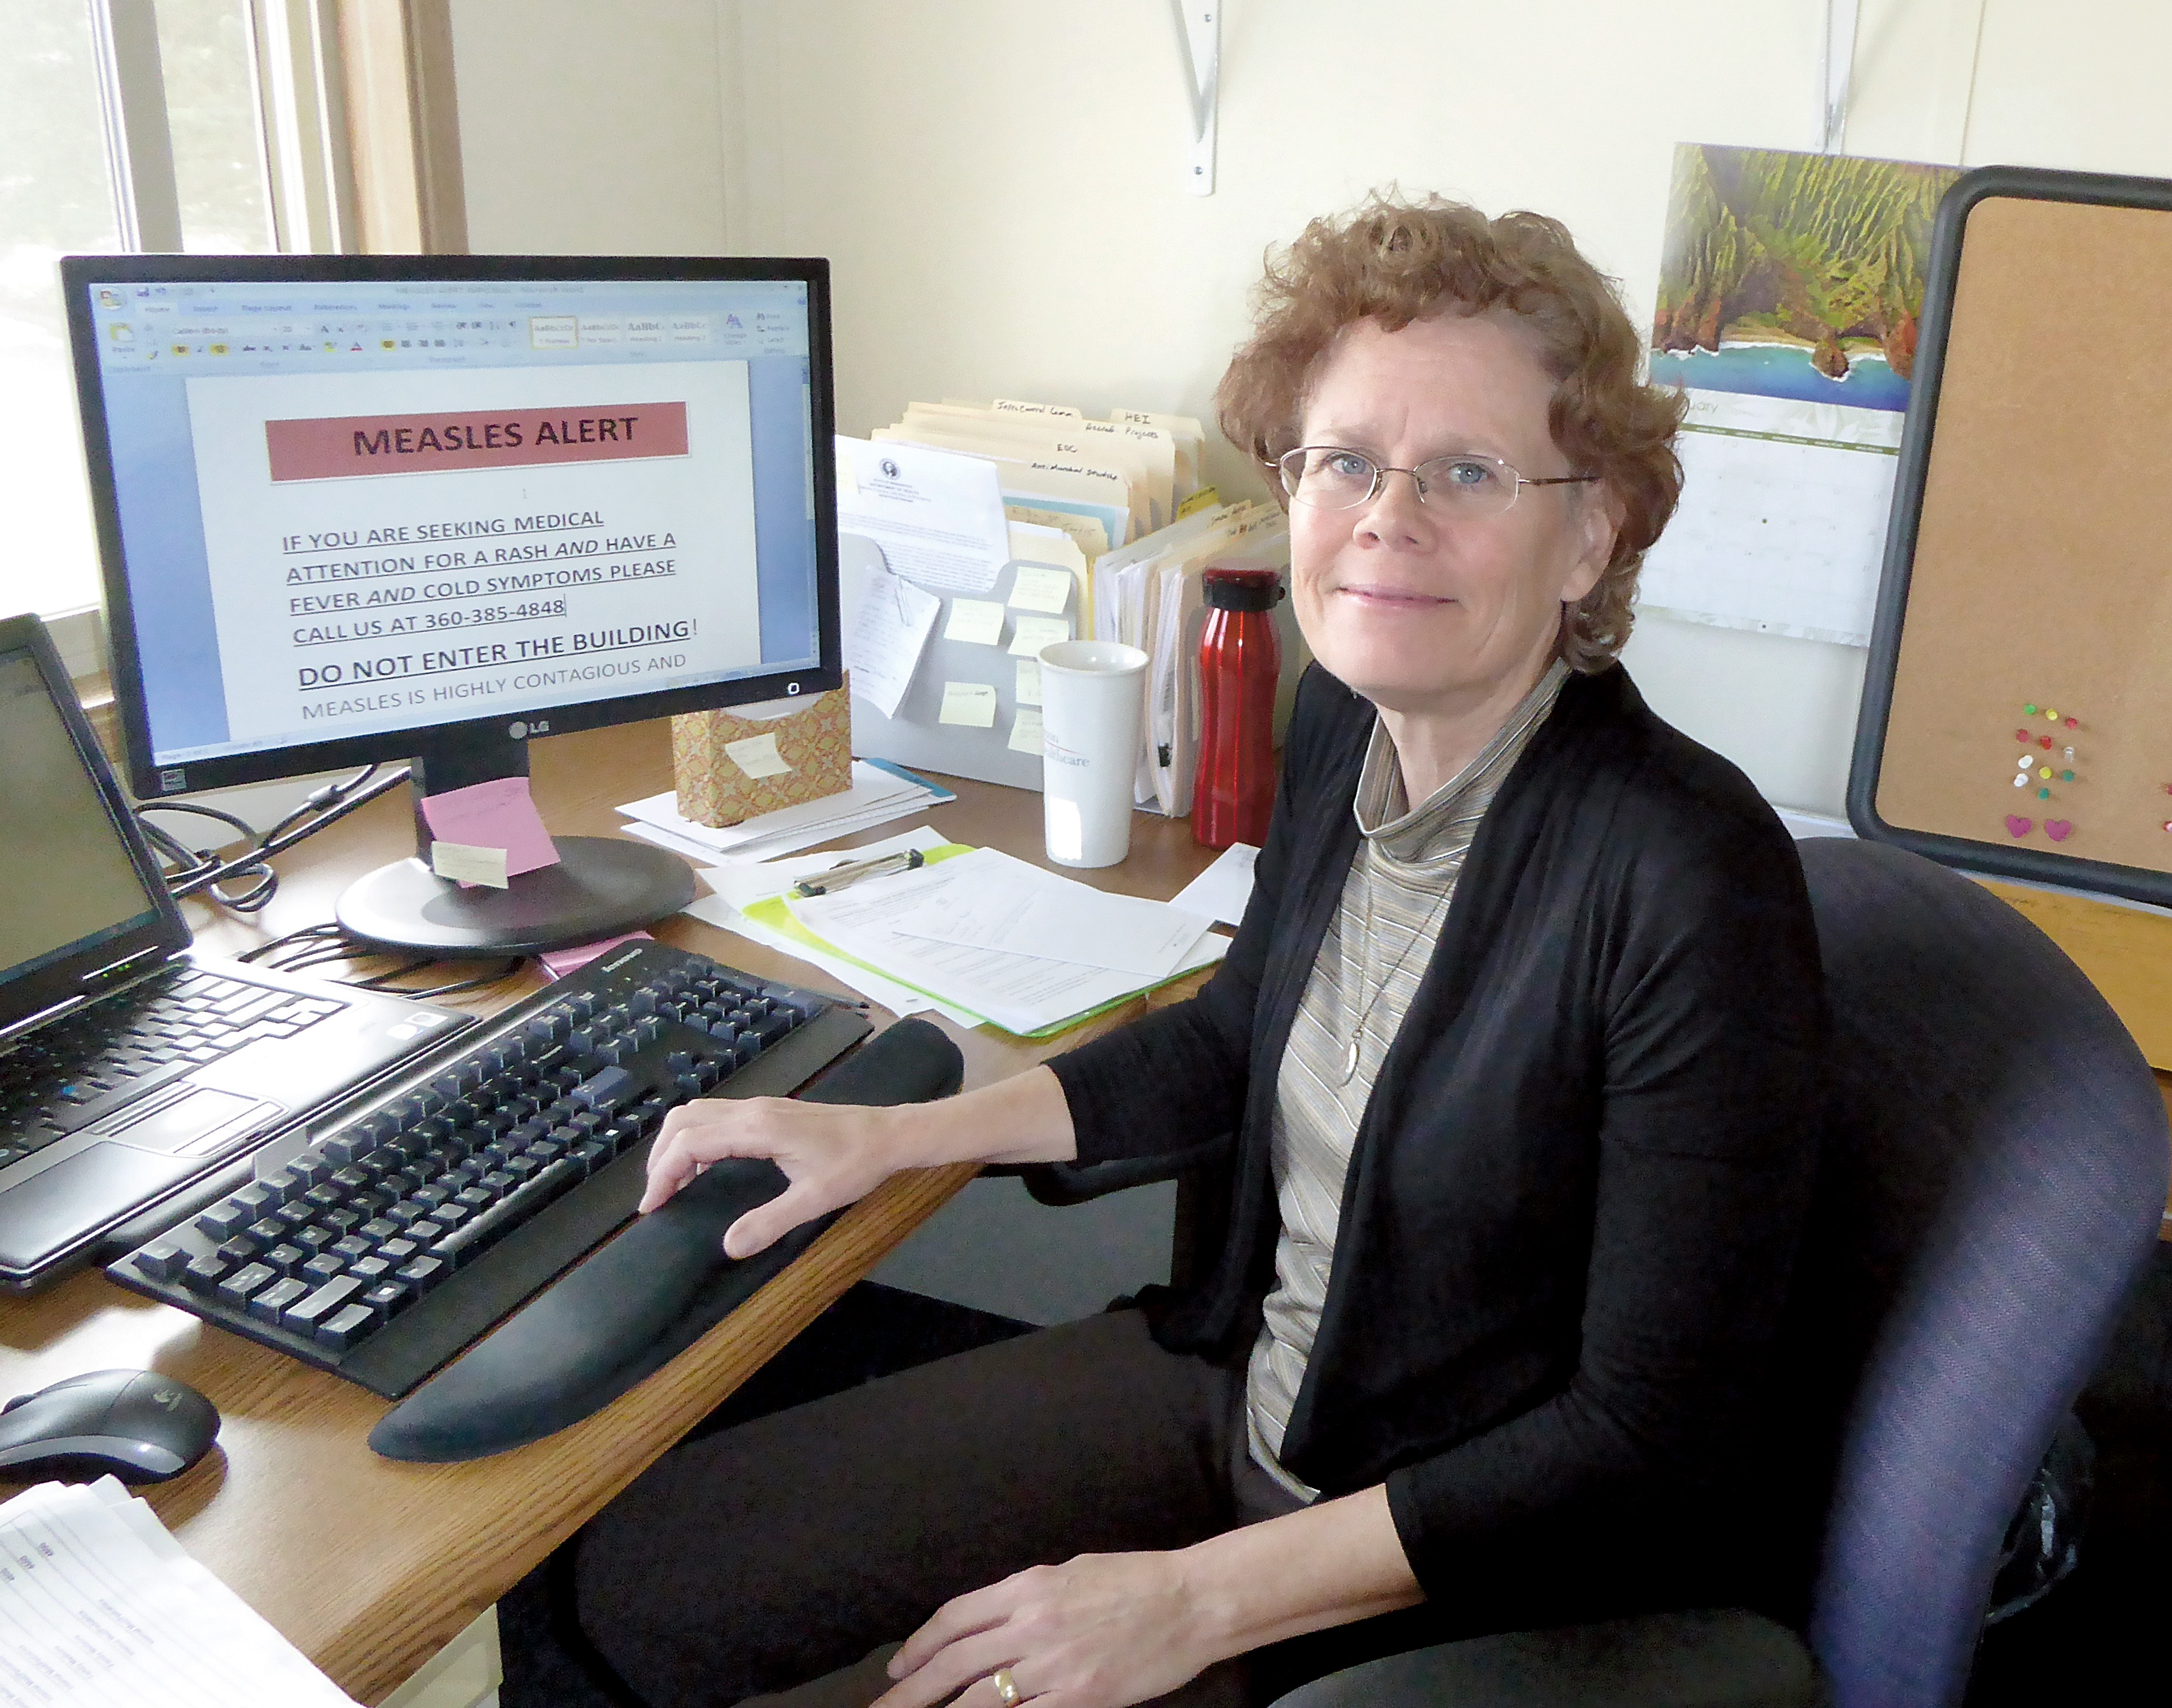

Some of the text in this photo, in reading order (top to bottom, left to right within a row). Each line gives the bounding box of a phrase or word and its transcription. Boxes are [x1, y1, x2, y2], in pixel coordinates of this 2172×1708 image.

[354, 417, 638, 456] MEASLES ALERT
[283, 511, 604, 551] IF YOU ARE SEEKING MEDICAL
[287, 532, 676, 583] ATTENTION FOR A RASH AND HAVE A
[290, 560, 676, 613] FEVER AND COLD SYMPTOMS PLEASE
[294, 599, 564, 644] CALL US AT 360-385-4848
[299, 618, 698, 687] DO NOT ENTER THE BUILDING!
[302, 654, 686, 720] MEASLES IS HIGHLY CONTAGIOUS AND
[530, 720, 550, 734] LG
